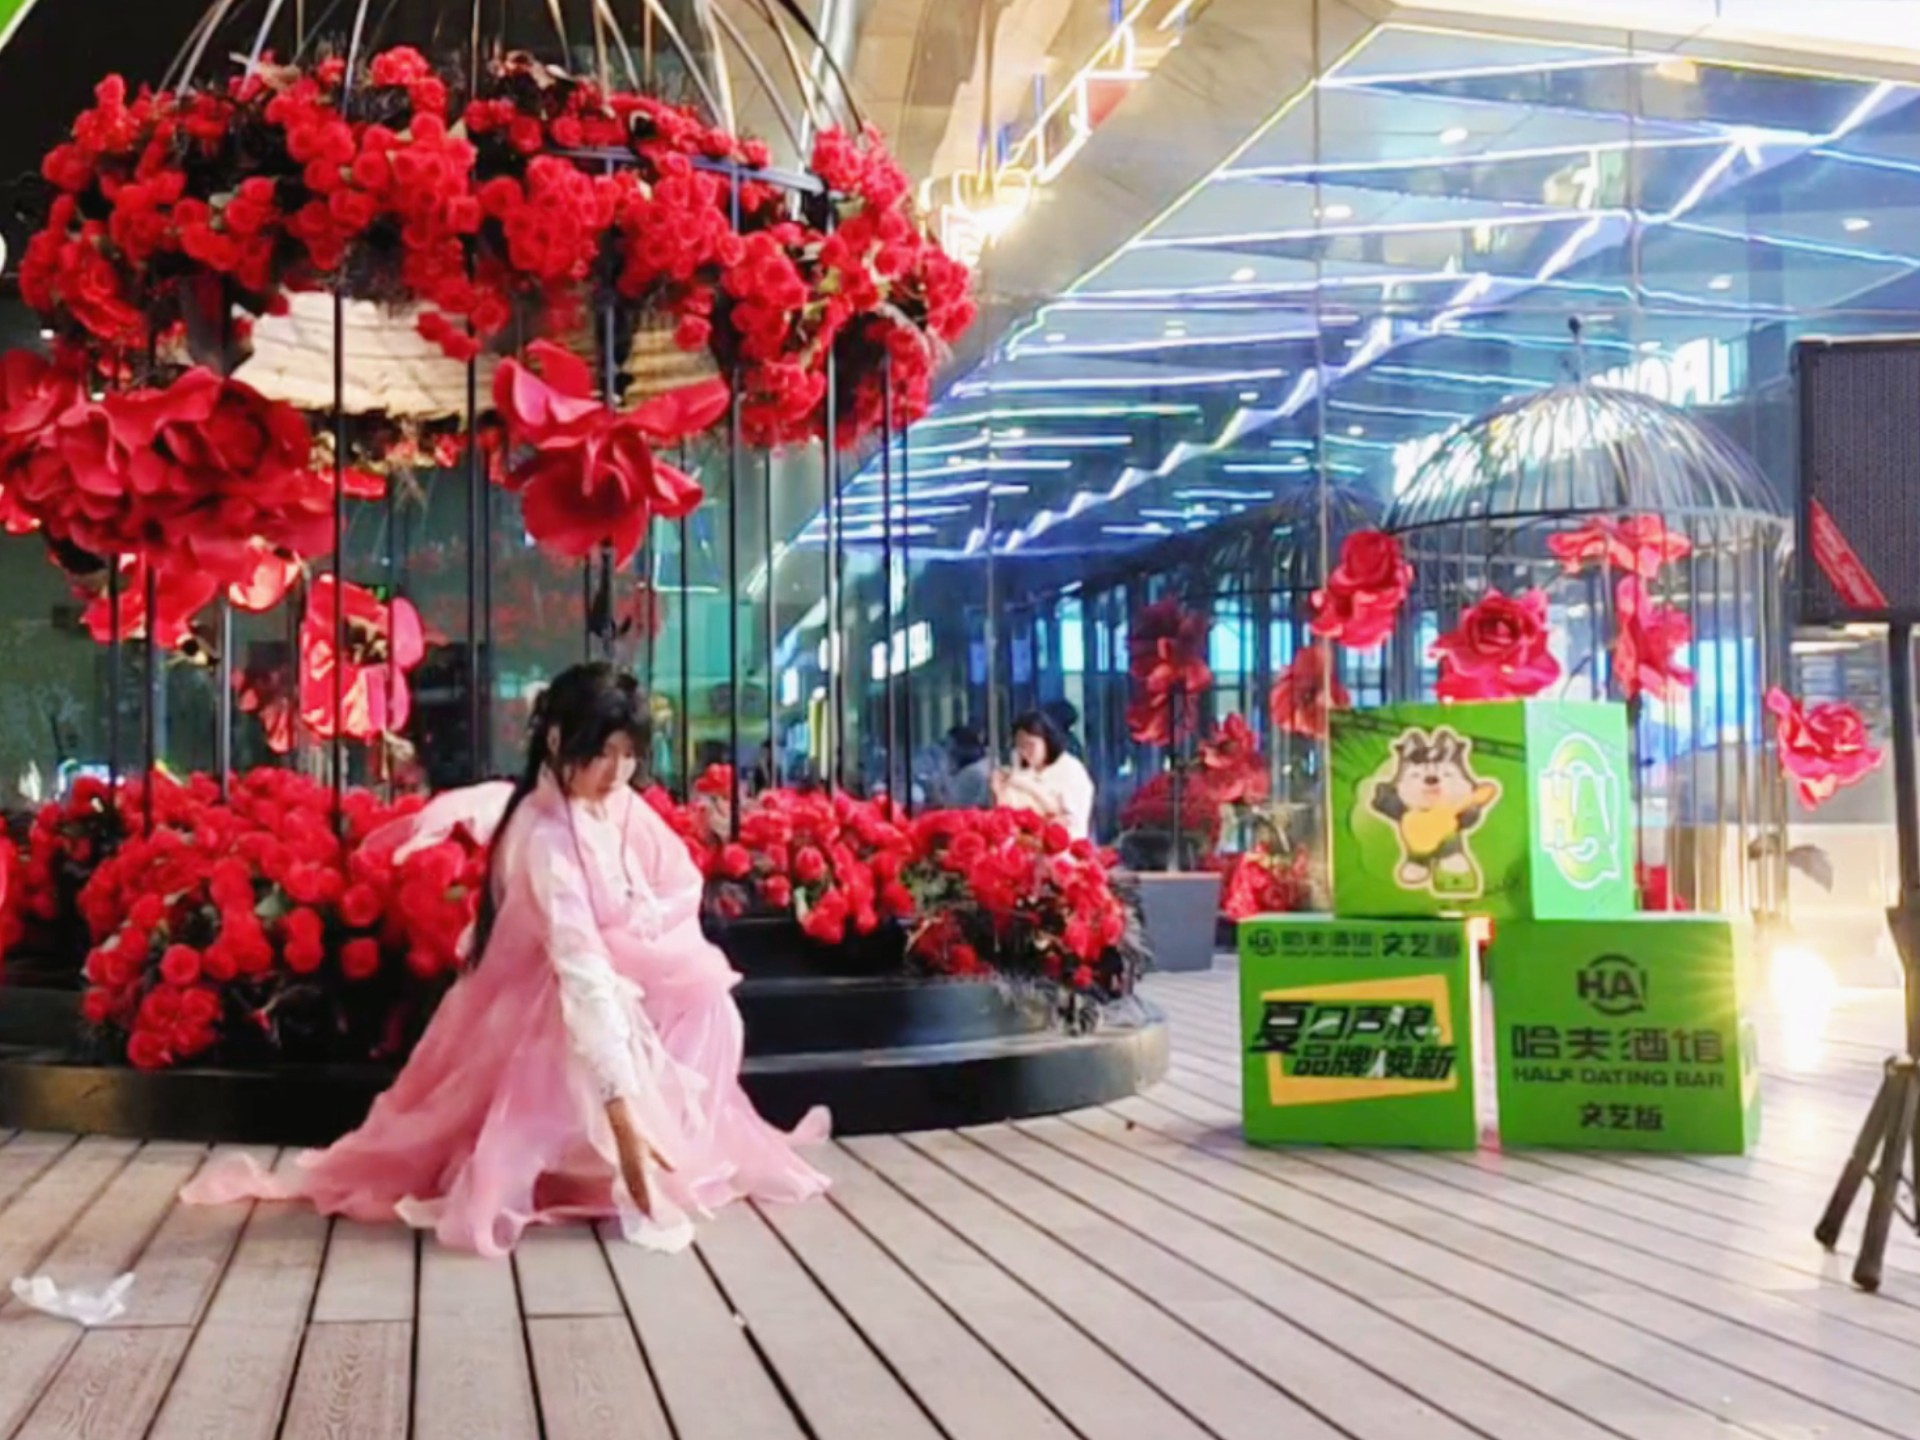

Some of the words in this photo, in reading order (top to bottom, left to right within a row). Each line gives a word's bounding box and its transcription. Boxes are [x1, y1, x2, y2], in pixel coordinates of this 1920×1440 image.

[1293, 1045, 1457, 1079] 品牌焕新
[1511, 1026, 1725, 1064] 哈夫酒馆
[1513, 1067, 1574, 1083] HALF
[1581, 1068, 1668, 1087] DATING
[1674, 1072, 1725, 1088] BAR
